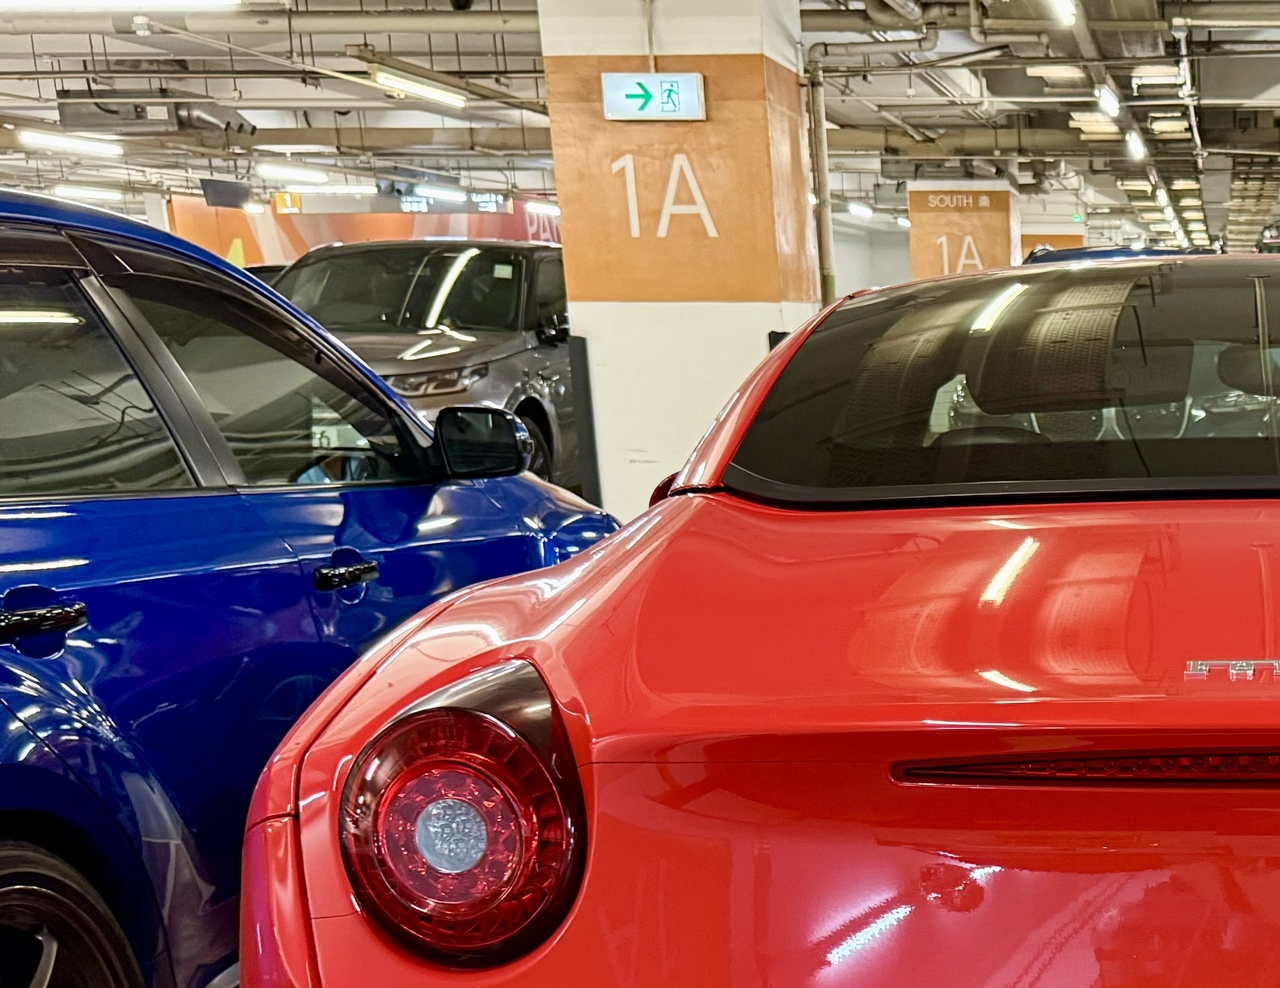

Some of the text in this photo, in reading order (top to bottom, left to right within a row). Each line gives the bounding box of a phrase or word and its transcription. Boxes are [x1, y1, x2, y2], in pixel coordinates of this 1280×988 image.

[610, 153, 720, 238] 1A
[928, 195, 973, 208] SOUTH
[936, 234, 985, 276] 1A
